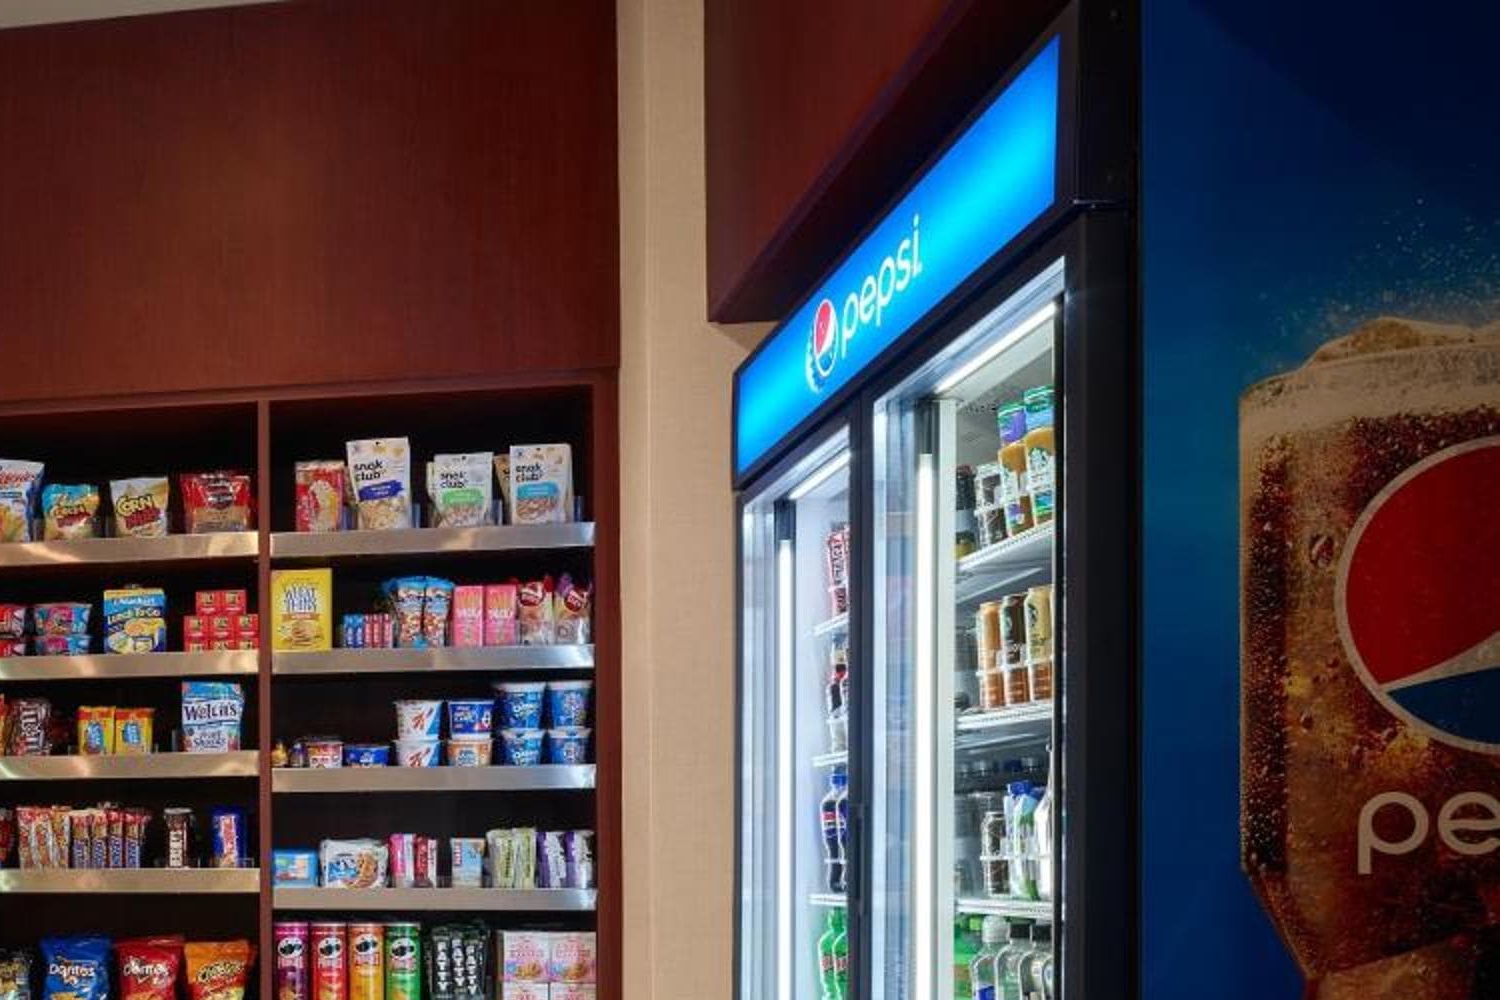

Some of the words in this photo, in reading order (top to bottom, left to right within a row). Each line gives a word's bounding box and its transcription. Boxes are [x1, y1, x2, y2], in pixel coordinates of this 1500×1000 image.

[841, 213, 922, 359] pepsi
[183, 701, 238, 722] Welch's
[49, 963, 96, 978] Doritos
